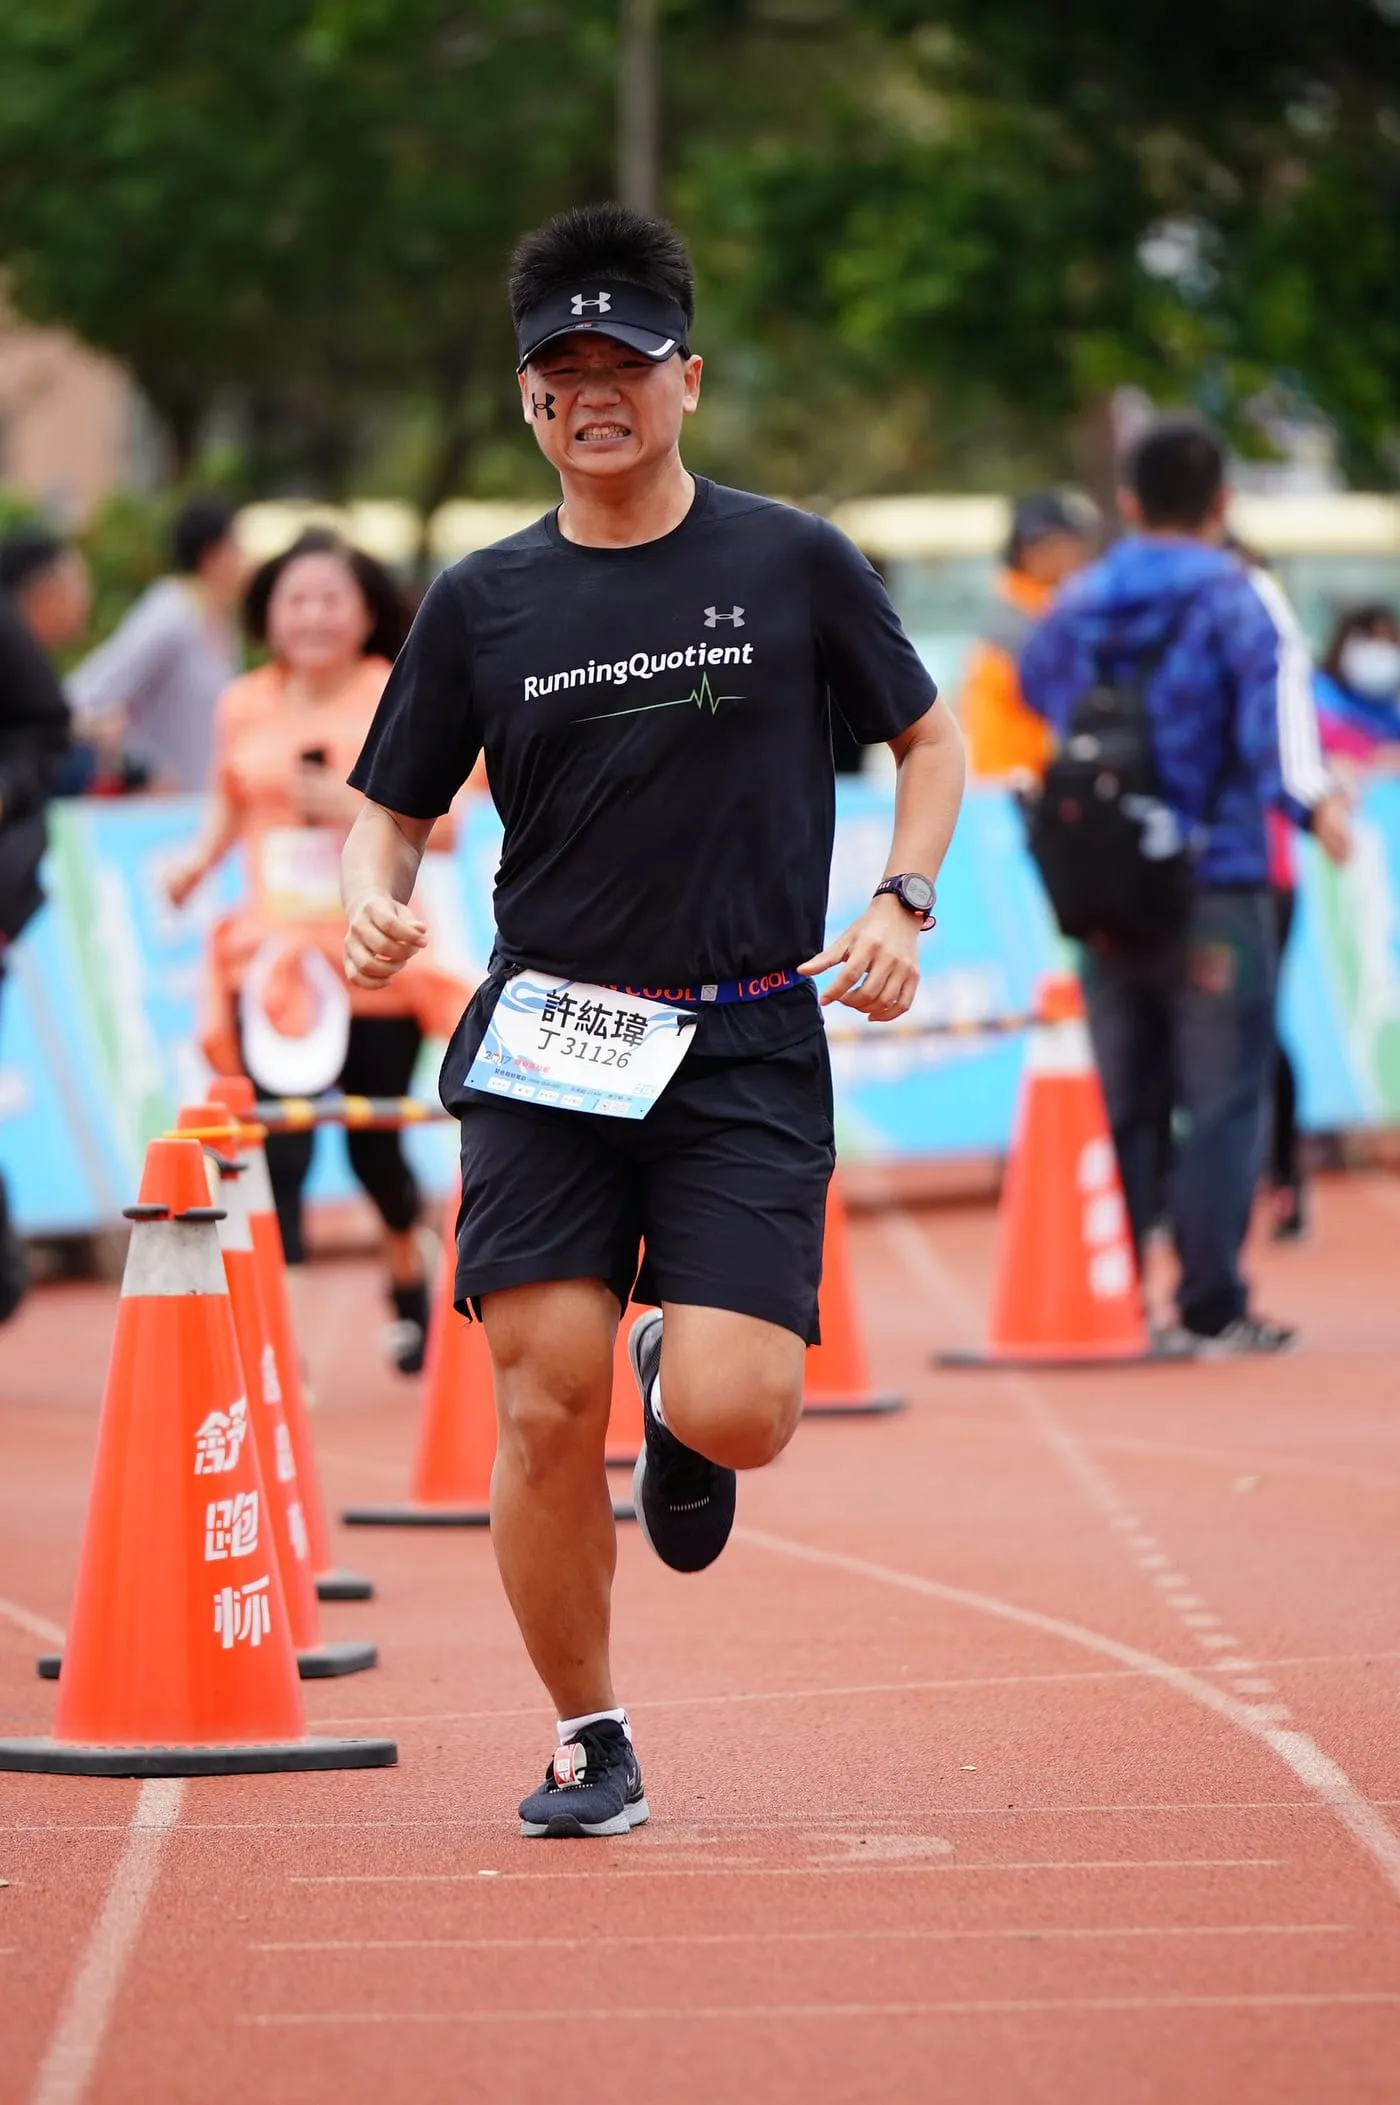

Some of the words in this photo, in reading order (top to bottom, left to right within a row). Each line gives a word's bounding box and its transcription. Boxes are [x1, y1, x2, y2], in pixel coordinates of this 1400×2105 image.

[524, 642, 754, 700] RunningQuotient
[748, 970, 790, 996] COOL
[541, 989, 648, 1046] 許紘瑋
